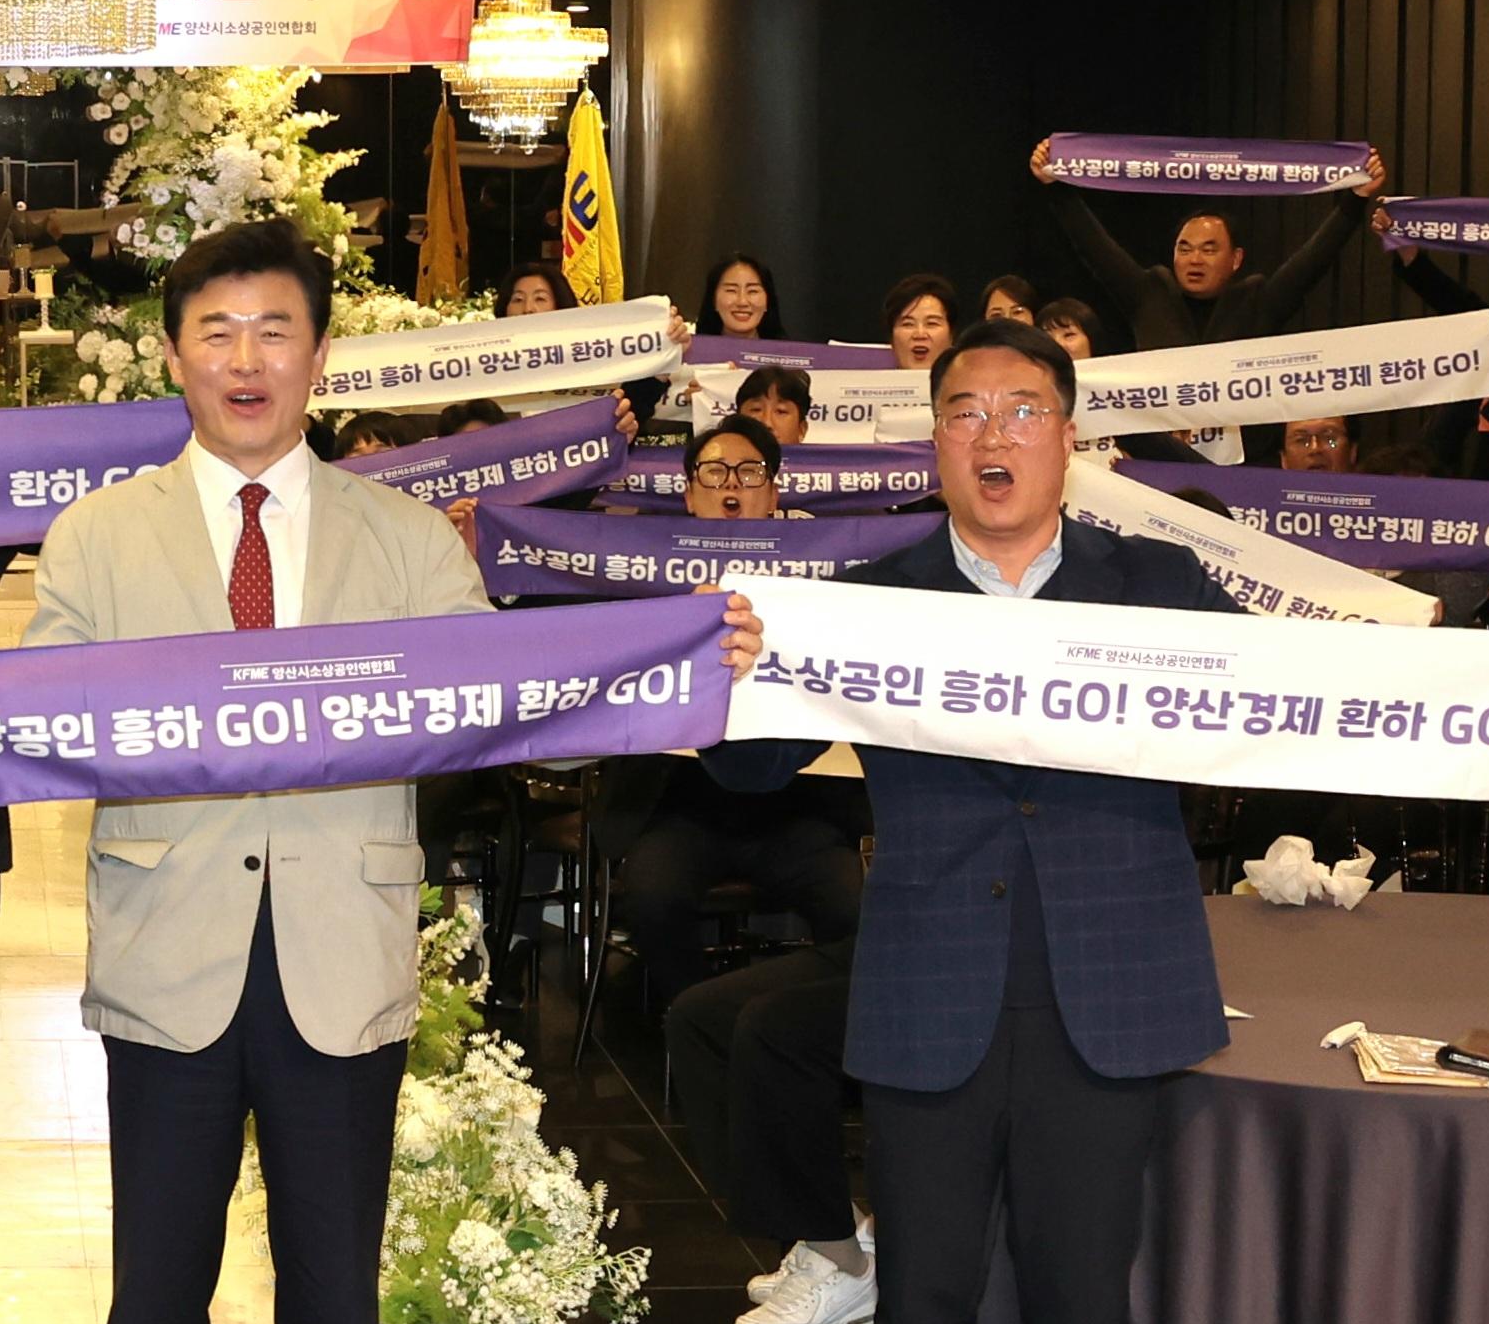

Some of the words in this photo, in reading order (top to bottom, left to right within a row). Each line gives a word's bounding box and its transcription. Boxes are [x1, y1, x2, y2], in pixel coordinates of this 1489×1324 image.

[185, 21, 316, 35] 양산시소상공인연합회
[1126, 161, 1160, 177] 흥하
[1165, 162, 1201, 179] GO!
[1206, 161, 1280, 182] 양산경제
[1283, 165, 1319, 182] 환하
[1087, 386, 1169, 411] 소상공인
[1177, 381, 1220, 406] 흥하
[1228, 376, 1271, 401] GO!
[1279, 365, 1371, 395] 양산경제
[1379, 359, 1426, 385] 환하
[1434, 350, 1479, 376] GO!
[10, 469, 94, 510] 환하
[1276, 512, 1320, 536] GO!
[1329, 515, 1423, 543] 양산경제
[1431, 520, 1479, 545] 환하
[497, 540, 595, 576] 소상공인
[605, 555, 657, 581] 흥하
[665, 558, 721, 586] GO!
[112, 706, 202, 755] 흥하
[217, 699, 305, 746] GO!
[321, 683, 501, 740] 양산경제
[517, 677, 599, 721] 환하
[607, 661, 691, 704] GO!
[753, 655, 923, 706] 소상공인
[941, 670, 1027, 715] 흥하
[1042, 680, 1127, 724] GO!
[1146, 686, 1323, 735] 양산경제
[1337, 699, 1427, 741] 환하
